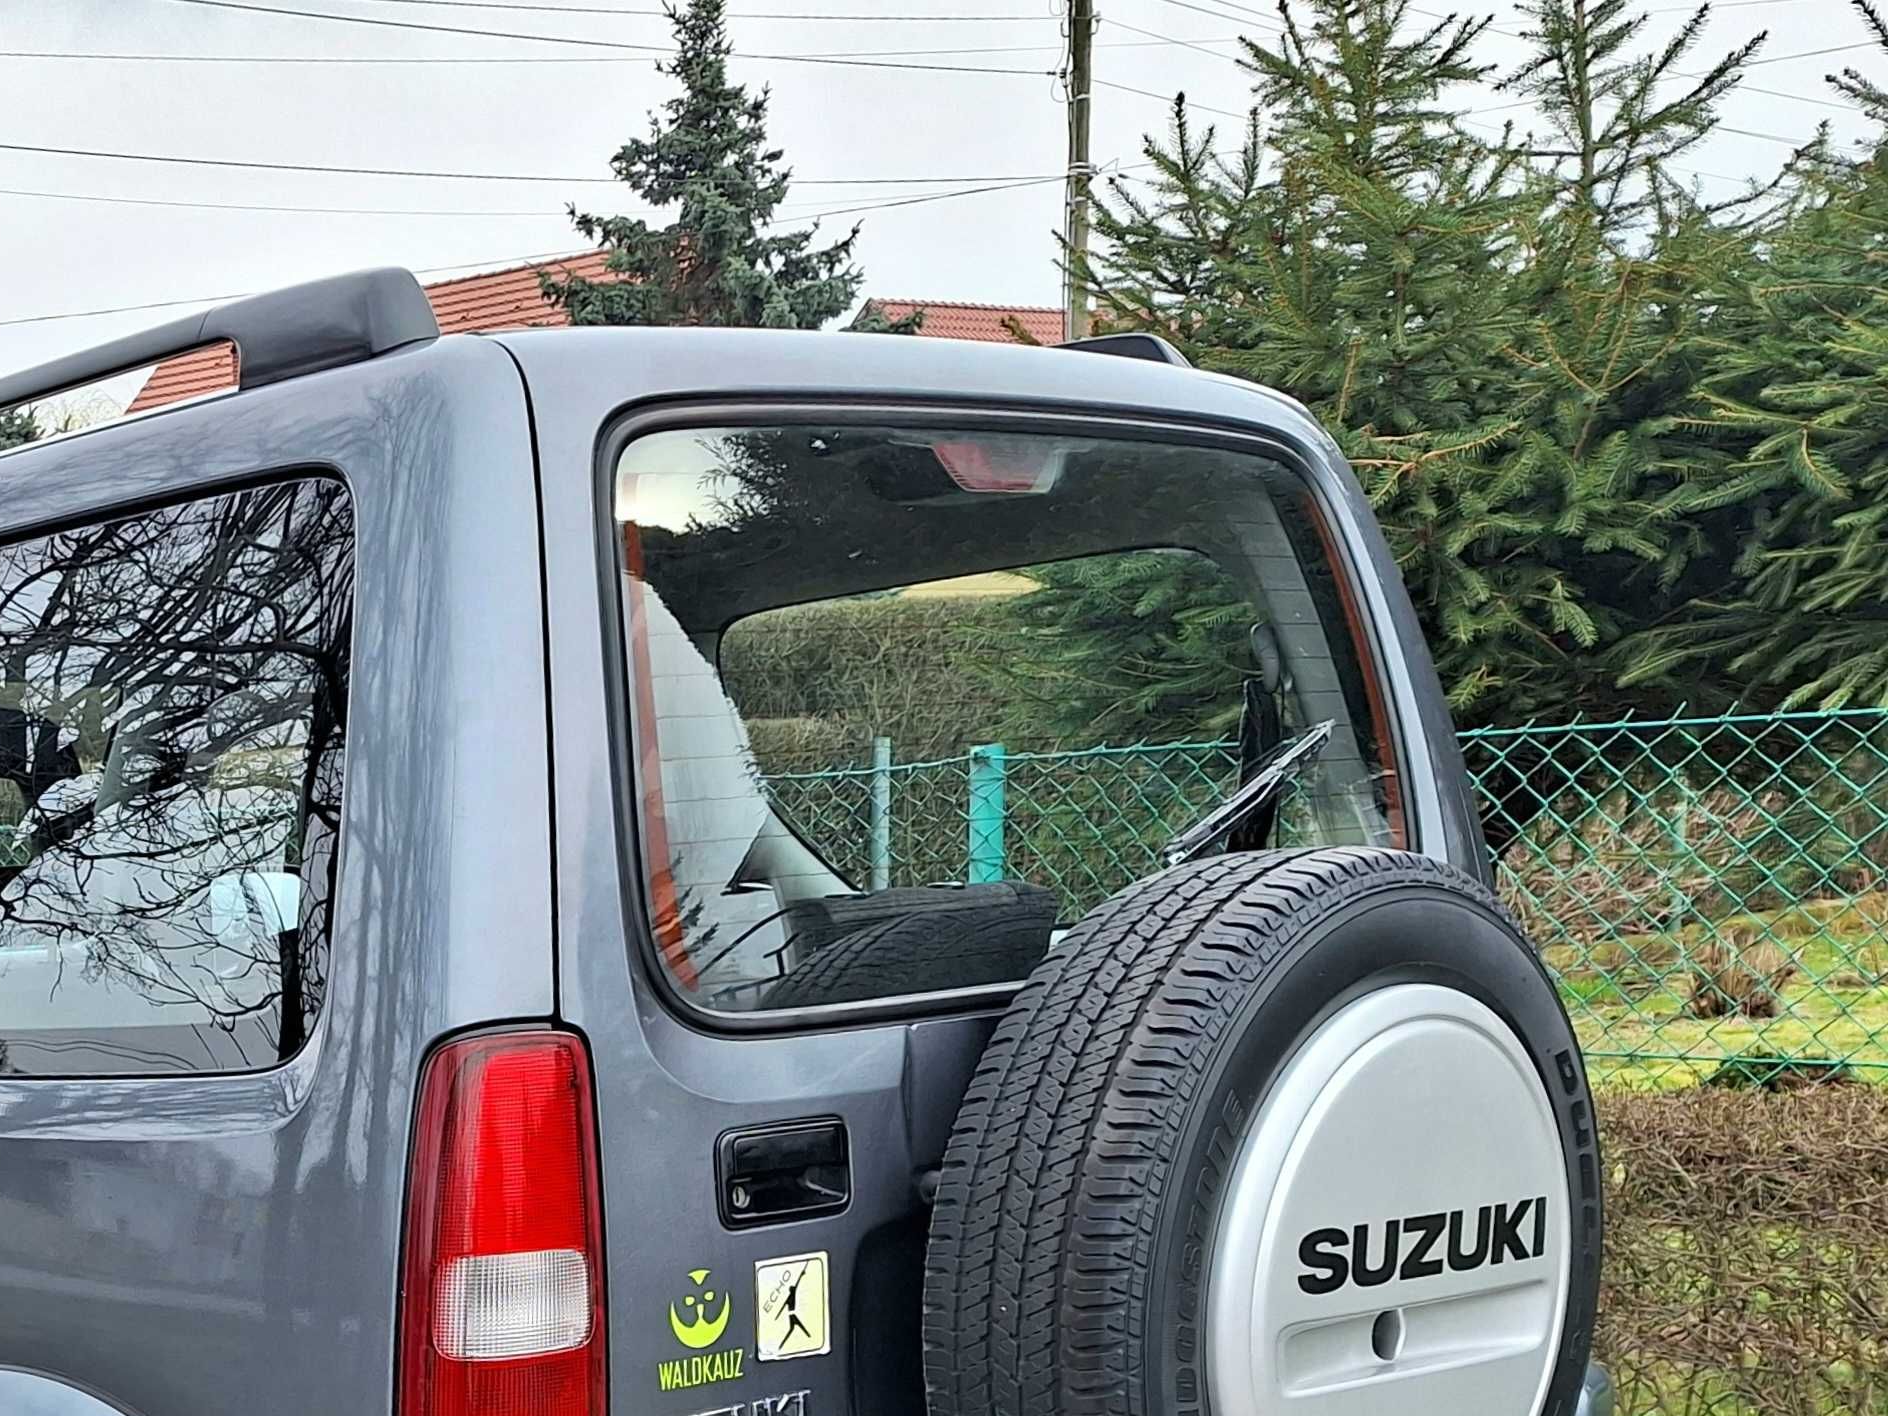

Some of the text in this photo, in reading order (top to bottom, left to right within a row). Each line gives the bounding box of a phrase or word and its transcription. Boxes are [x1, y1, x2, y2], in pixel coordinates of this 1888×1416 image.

[1297, 1196, 1548, 1295] SUZUKI
[762, 1269, 792, 1314] ECHO
[658, 1349, 744, 1391] WALDKAUZ
